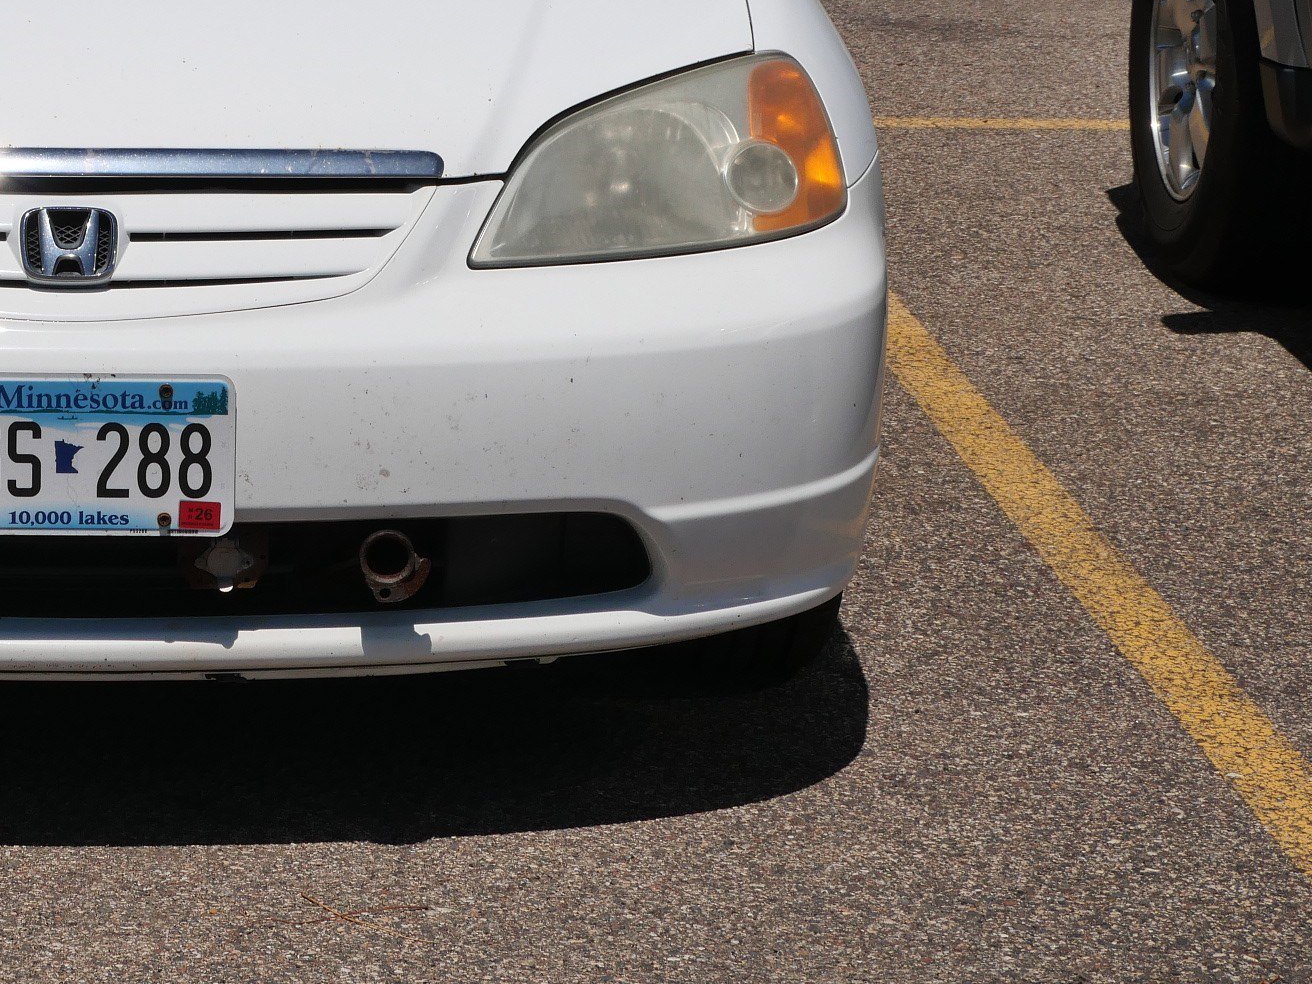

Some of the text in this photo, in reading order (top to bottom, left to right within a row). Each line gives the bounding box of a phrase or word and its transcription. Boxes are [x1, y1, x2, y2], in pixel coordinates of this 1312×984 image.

[96, 422, 212, 498] 288
[8, 511, 129, 526] 10,000 lakes
[194, 508, 213, 520] 26
